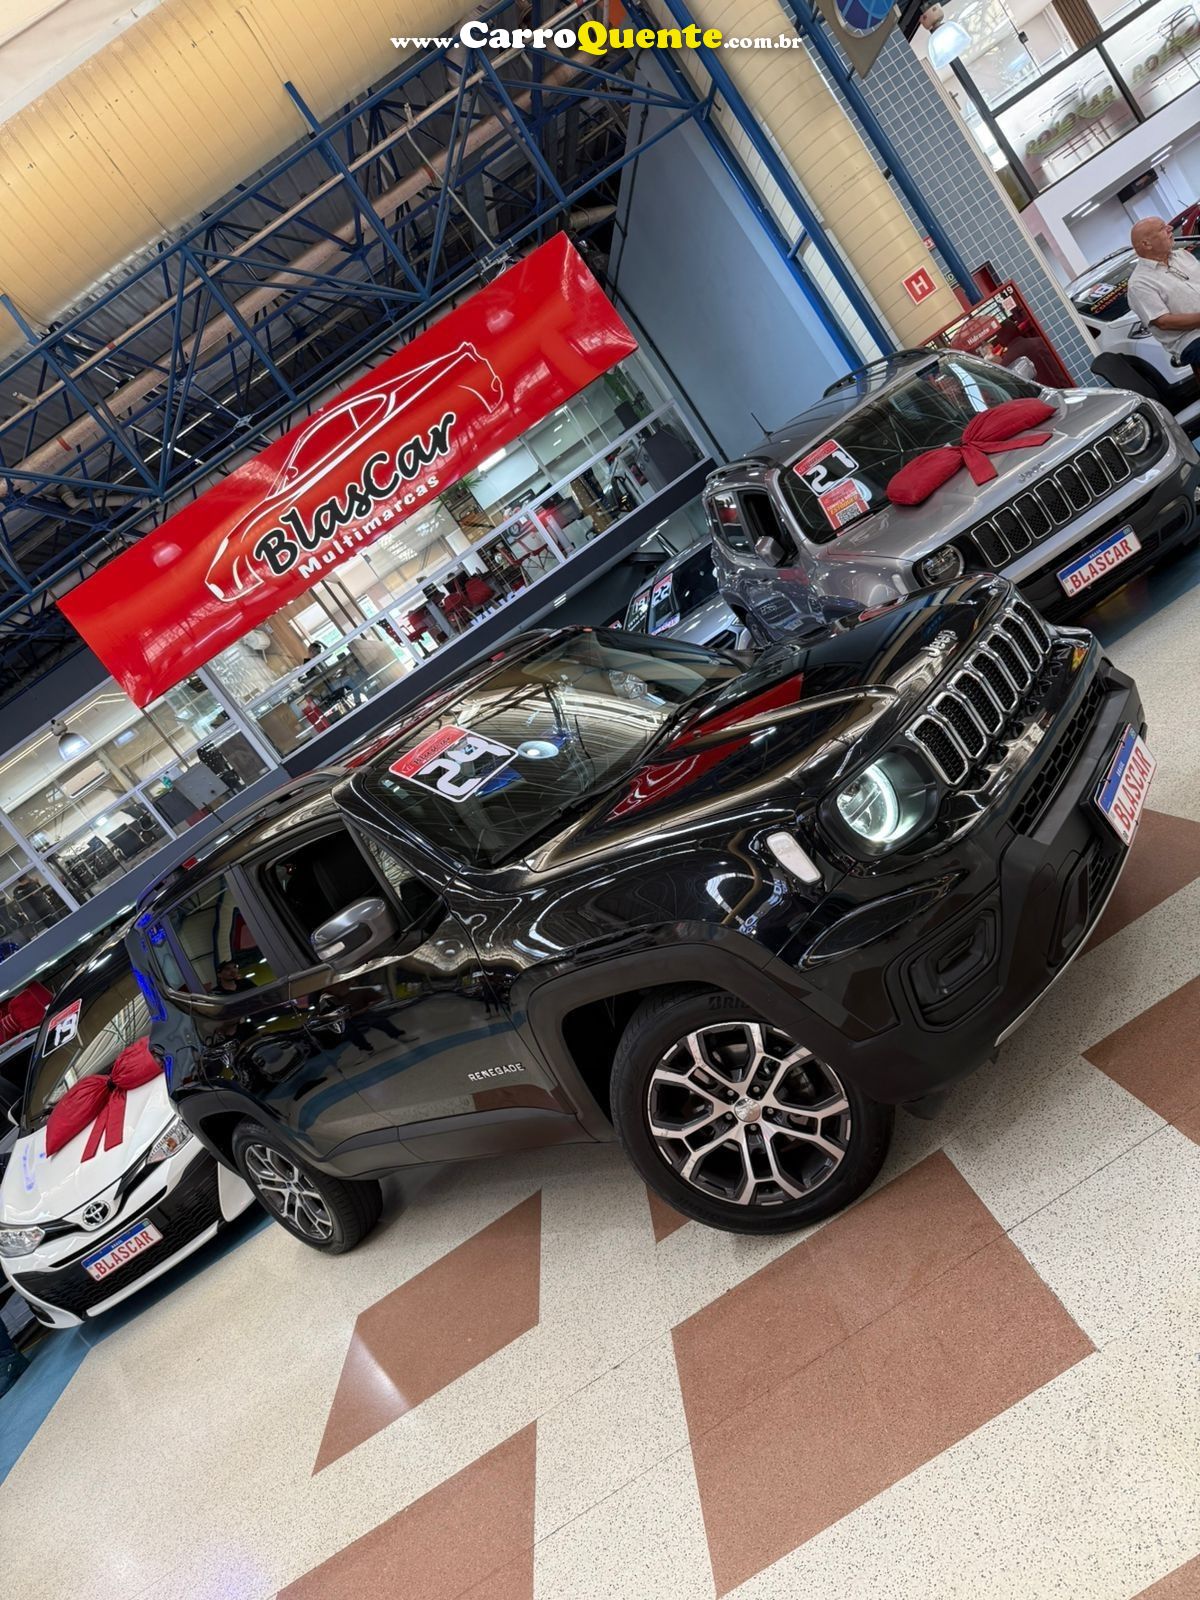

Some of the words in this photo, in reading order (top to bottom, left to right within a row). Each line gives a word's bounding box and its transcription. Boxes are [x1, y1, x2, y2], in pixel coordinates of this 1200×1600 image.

[910, 274, 929, 296] H
[1002, 285, 1014, 297] 19
[254, 411, 457, 576] BlasCar
[805, 449, 856, 493] 21
[298, 475, 440, 580] Multimarcas
[1069, 538, 1133, 590] BLASCAR
[920, 629, 958, 658] Jeep
[417, 736, 512, 796] 24
[1113, 745, 1152, 831] BLASCAR
[54, 1013, 77, 1047] 19
[467, 1062, 525, 1082] RENEGADE
[94, 1230, 154, 1276] BLASCAR
